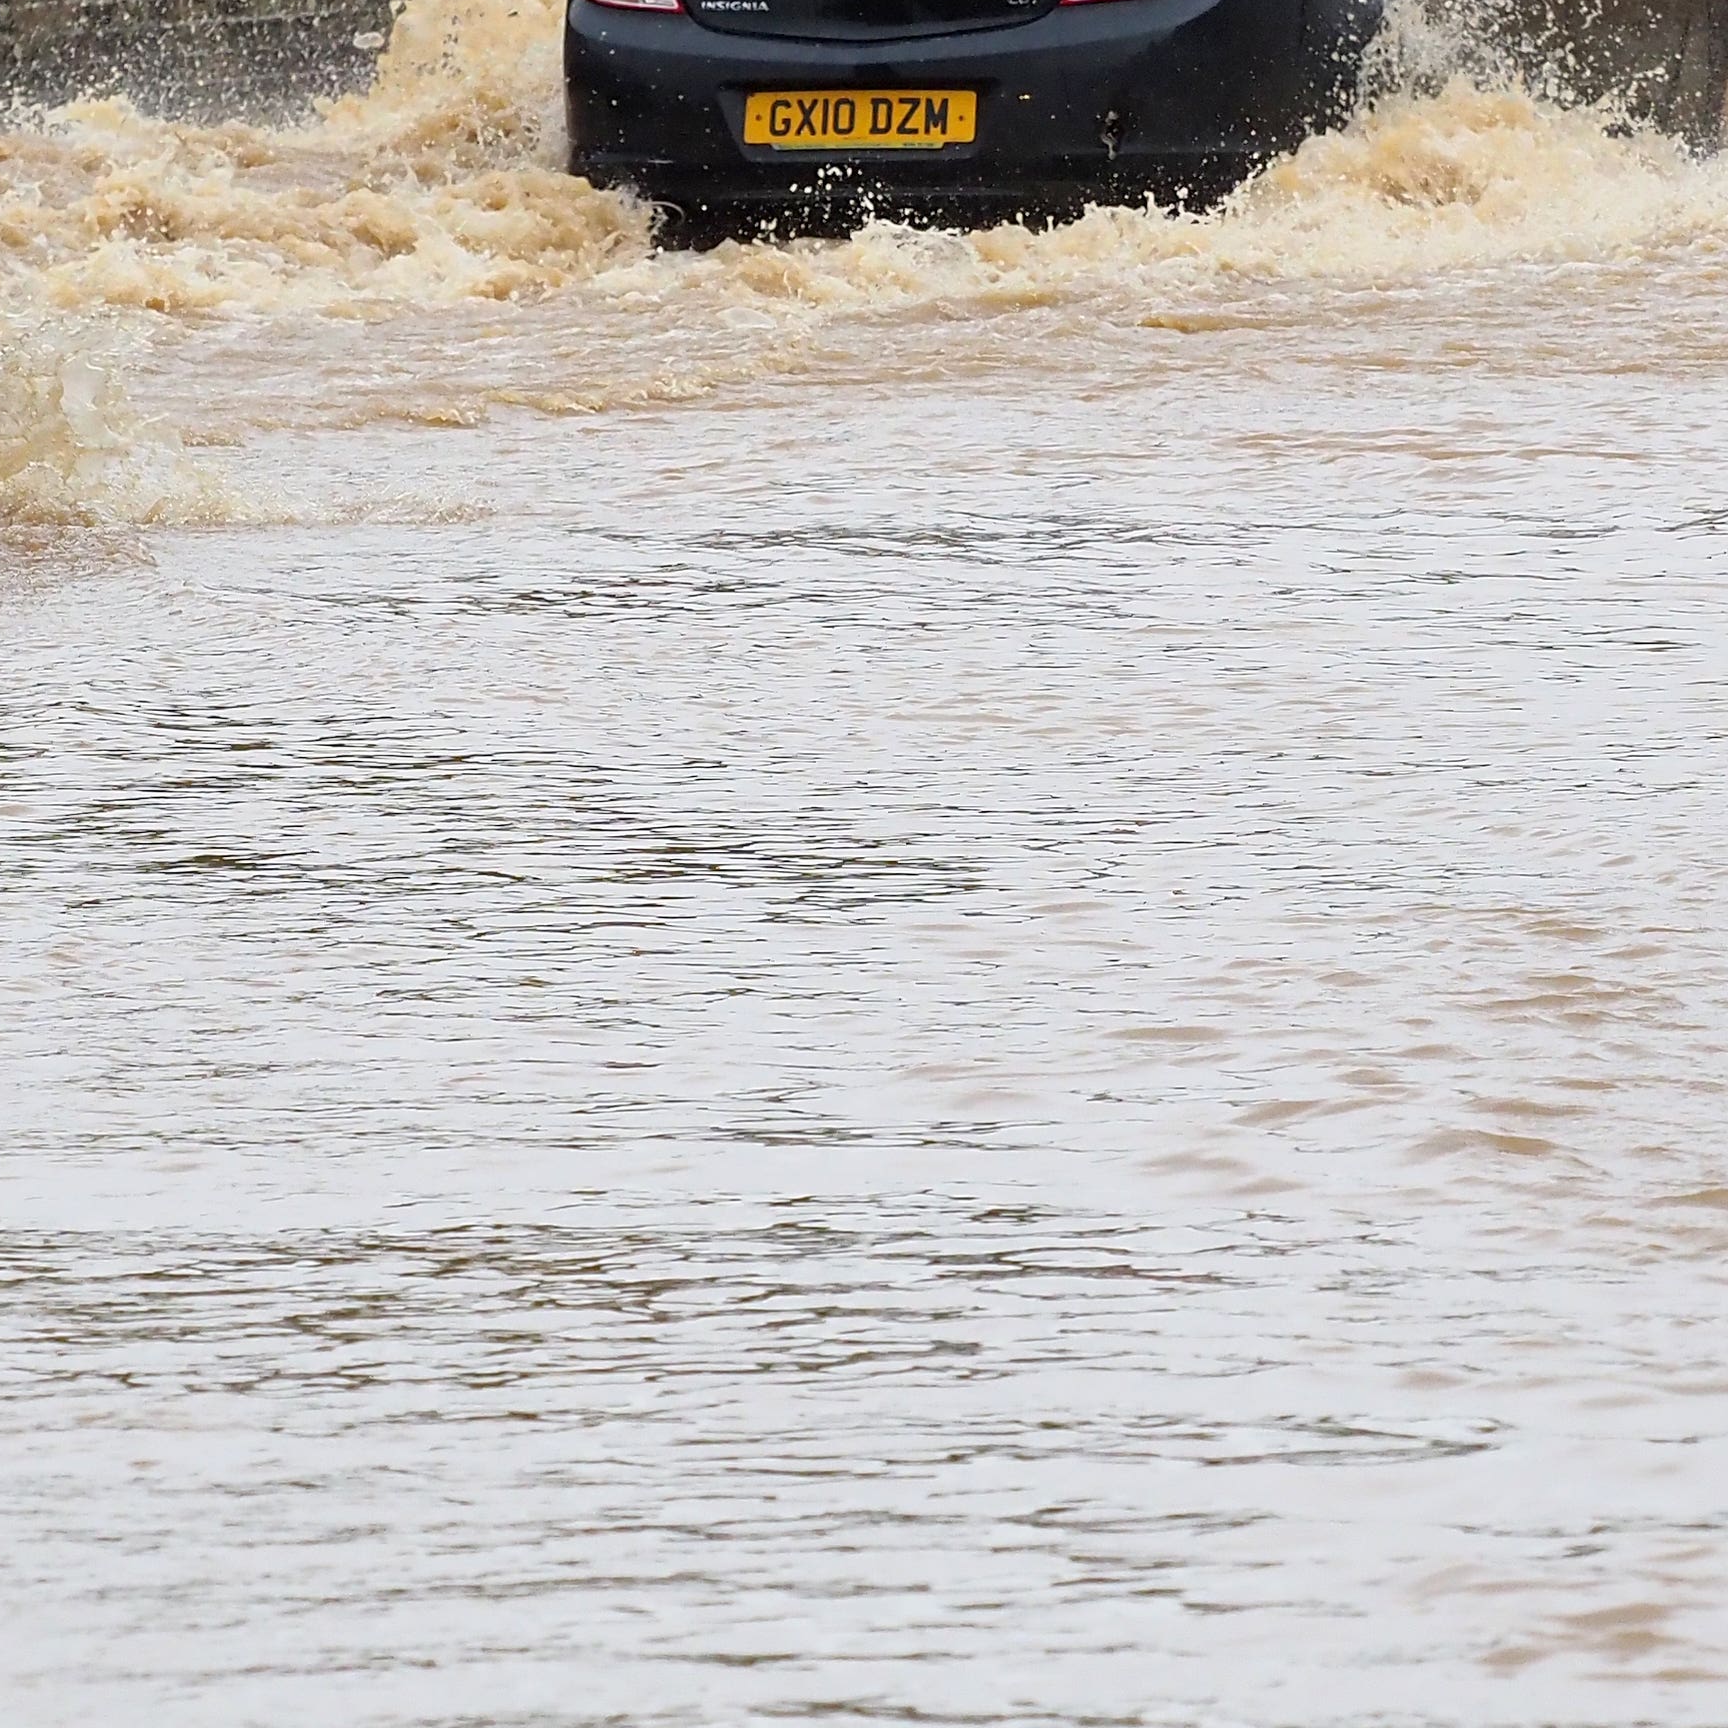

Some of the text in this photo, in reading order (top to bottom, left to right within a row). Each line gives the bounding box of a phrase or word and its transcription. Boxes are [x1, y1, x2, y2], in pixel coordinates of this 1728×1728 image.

[700, 0, 770, 12] INSIGNIA
[768, 97, 949, 137] GX10 DZM
